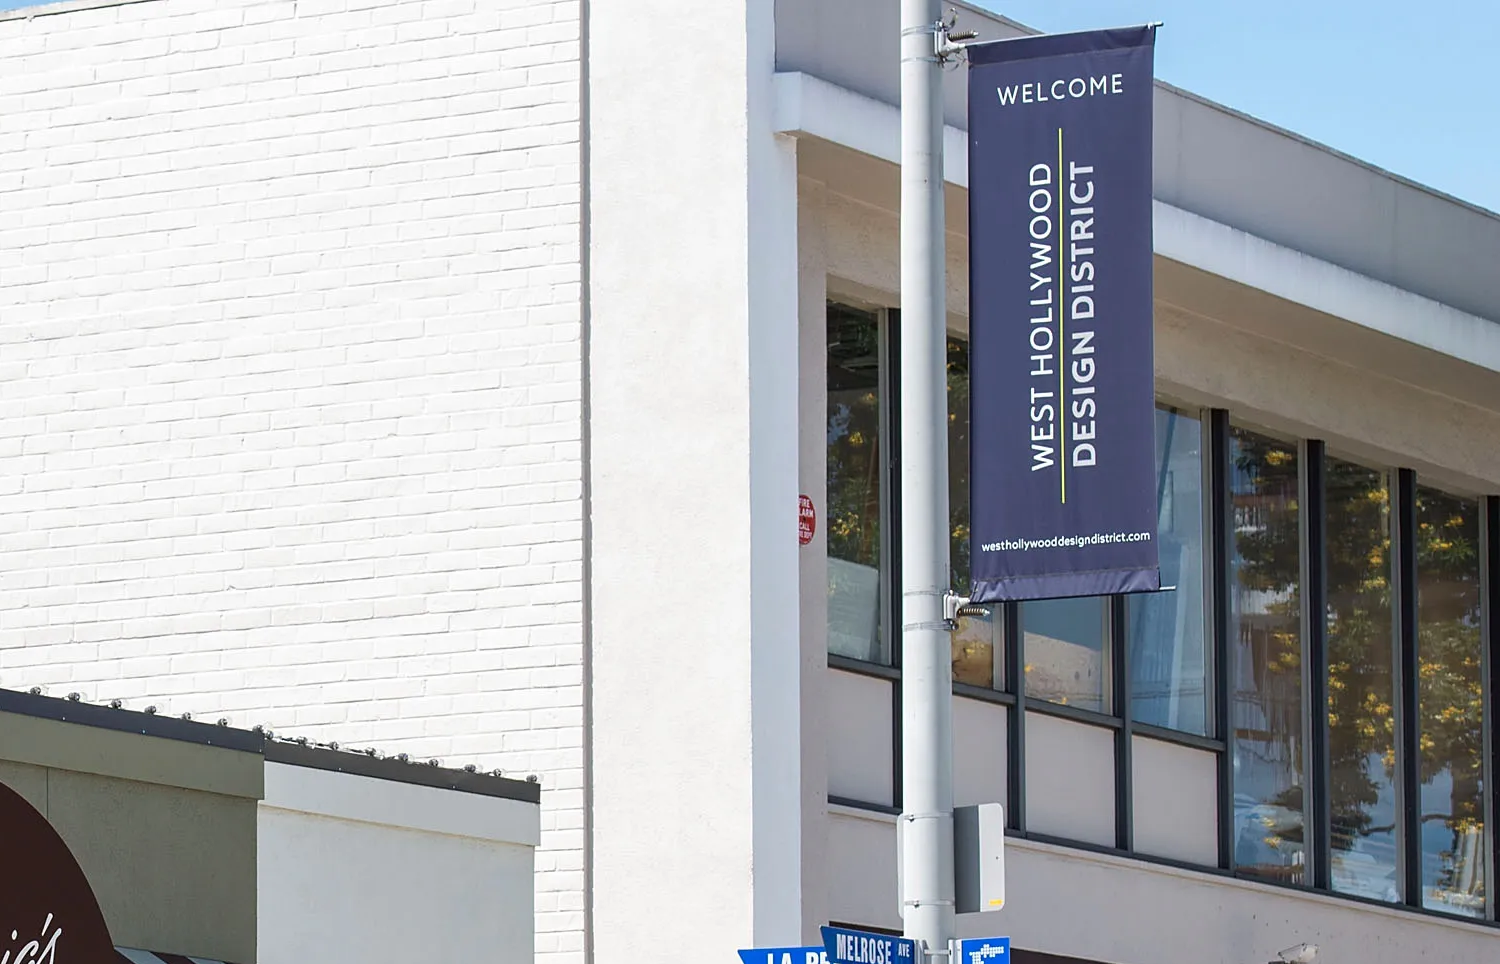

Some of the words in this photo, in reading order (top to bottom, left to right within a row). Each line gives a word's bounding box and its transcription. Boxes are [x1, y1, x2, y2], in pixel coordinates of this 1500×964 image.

[996, 73, 1124, 106] WELCOME
[1029, 163, 1054, 376] HOLLYWOOD
[1069, 161, 1095, 321] DISTRICT
[1030, 387, 1055, 472] WEST
[1071, 330, 1097, 467] DESIGN
[981, 530, 1151, 552] westhollywooddesigndistrict.com
[898, 943, 910, 958] AVE
